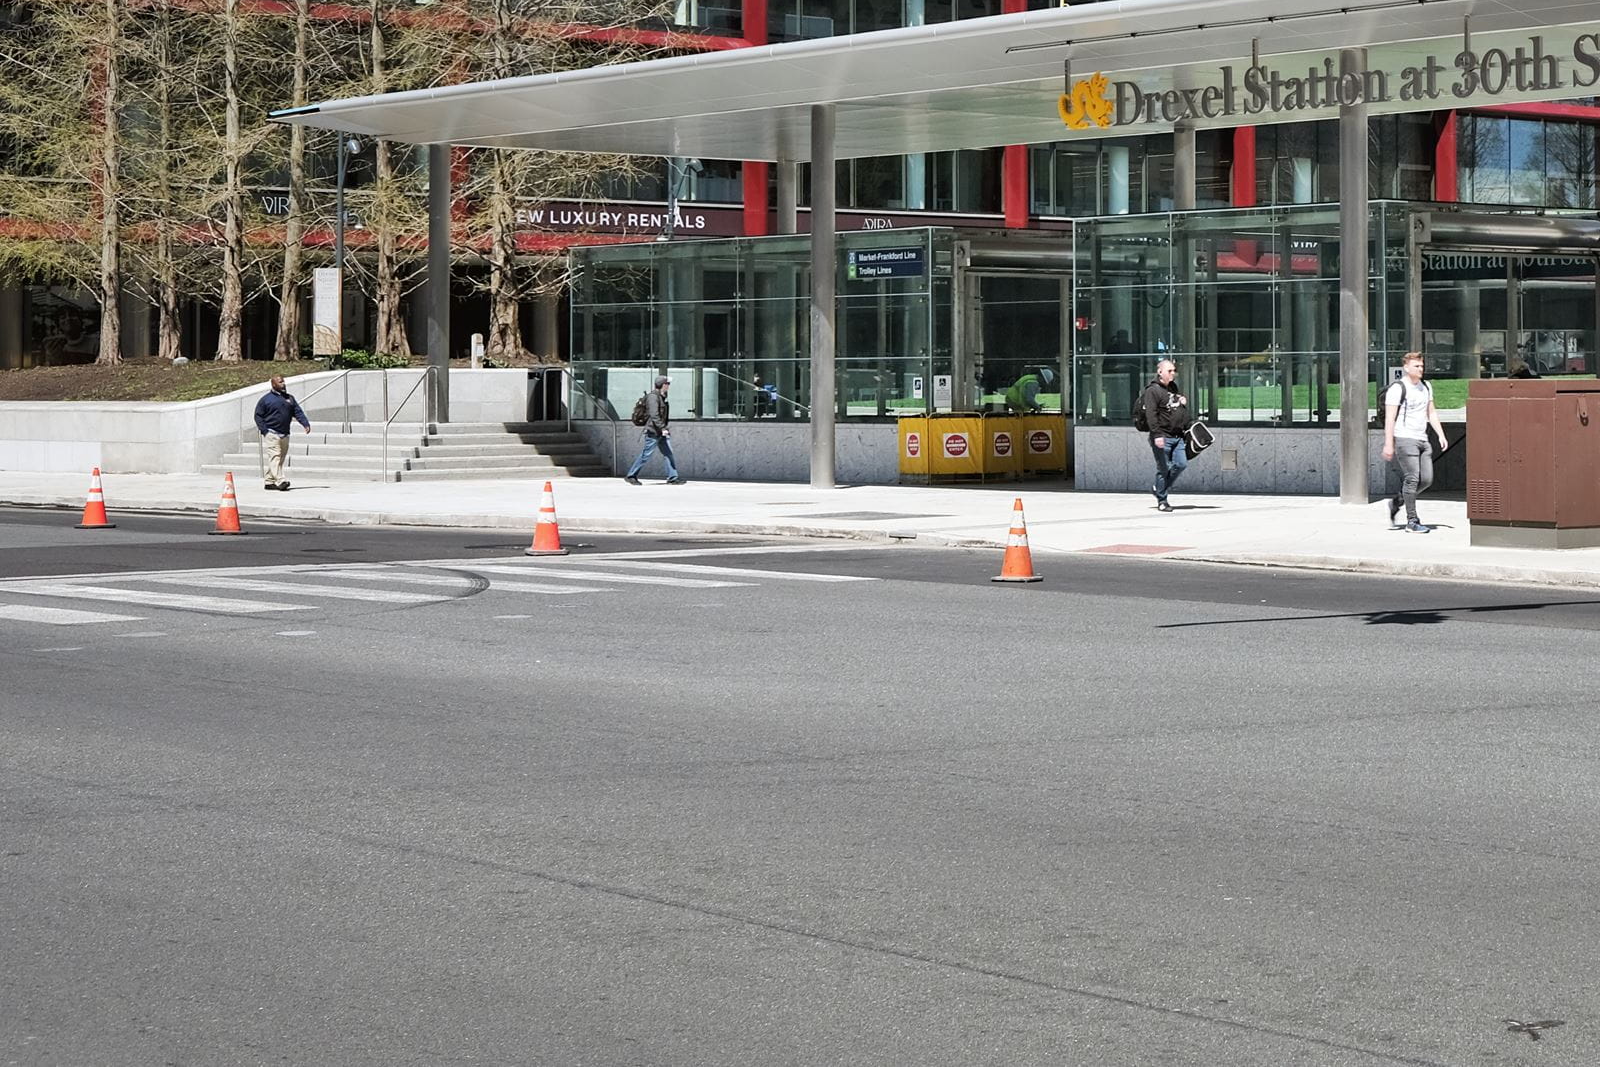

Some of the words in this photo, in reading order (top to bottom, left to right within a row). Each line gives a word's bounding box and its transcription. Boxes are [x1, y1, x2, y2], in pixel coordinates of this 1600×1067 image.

[1112, 65, 1235, 126] Drexel
[1244, 56, 1390, 114] Station
[1401, 55, 1443, 102] at
[1451, 35, 1562, 98] 30th
[516, 209, 545, 224] EW
[549, 210, 621, 226] LUXURY
[627, 213, 705, 229] RENTALS
[858, 252, 903, 262] Market-Frankford
[904, 251, 916, 260] Line
[858, 267, 877, 276] Trolley
[877, 266, 892, 275] Lines
